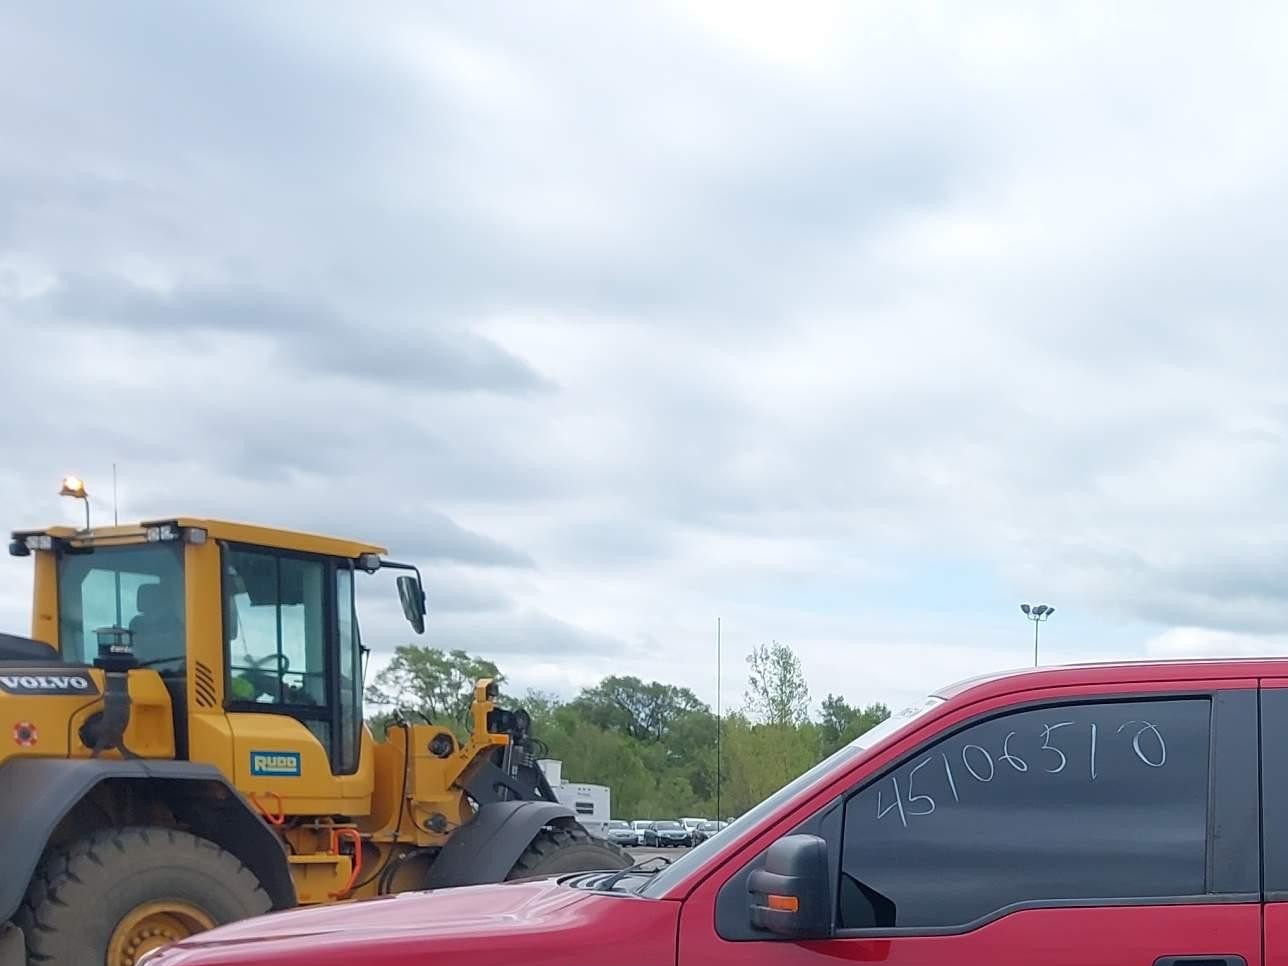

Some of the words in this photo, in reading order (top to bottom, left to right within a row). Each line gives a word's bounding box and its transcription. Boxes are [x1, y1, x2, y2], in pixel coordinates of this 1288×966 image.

[0, 676, 88, 689] VOLVO
[254, 756, 297, 772] RUDD
[876, 721, 1167, 828] 45106510
